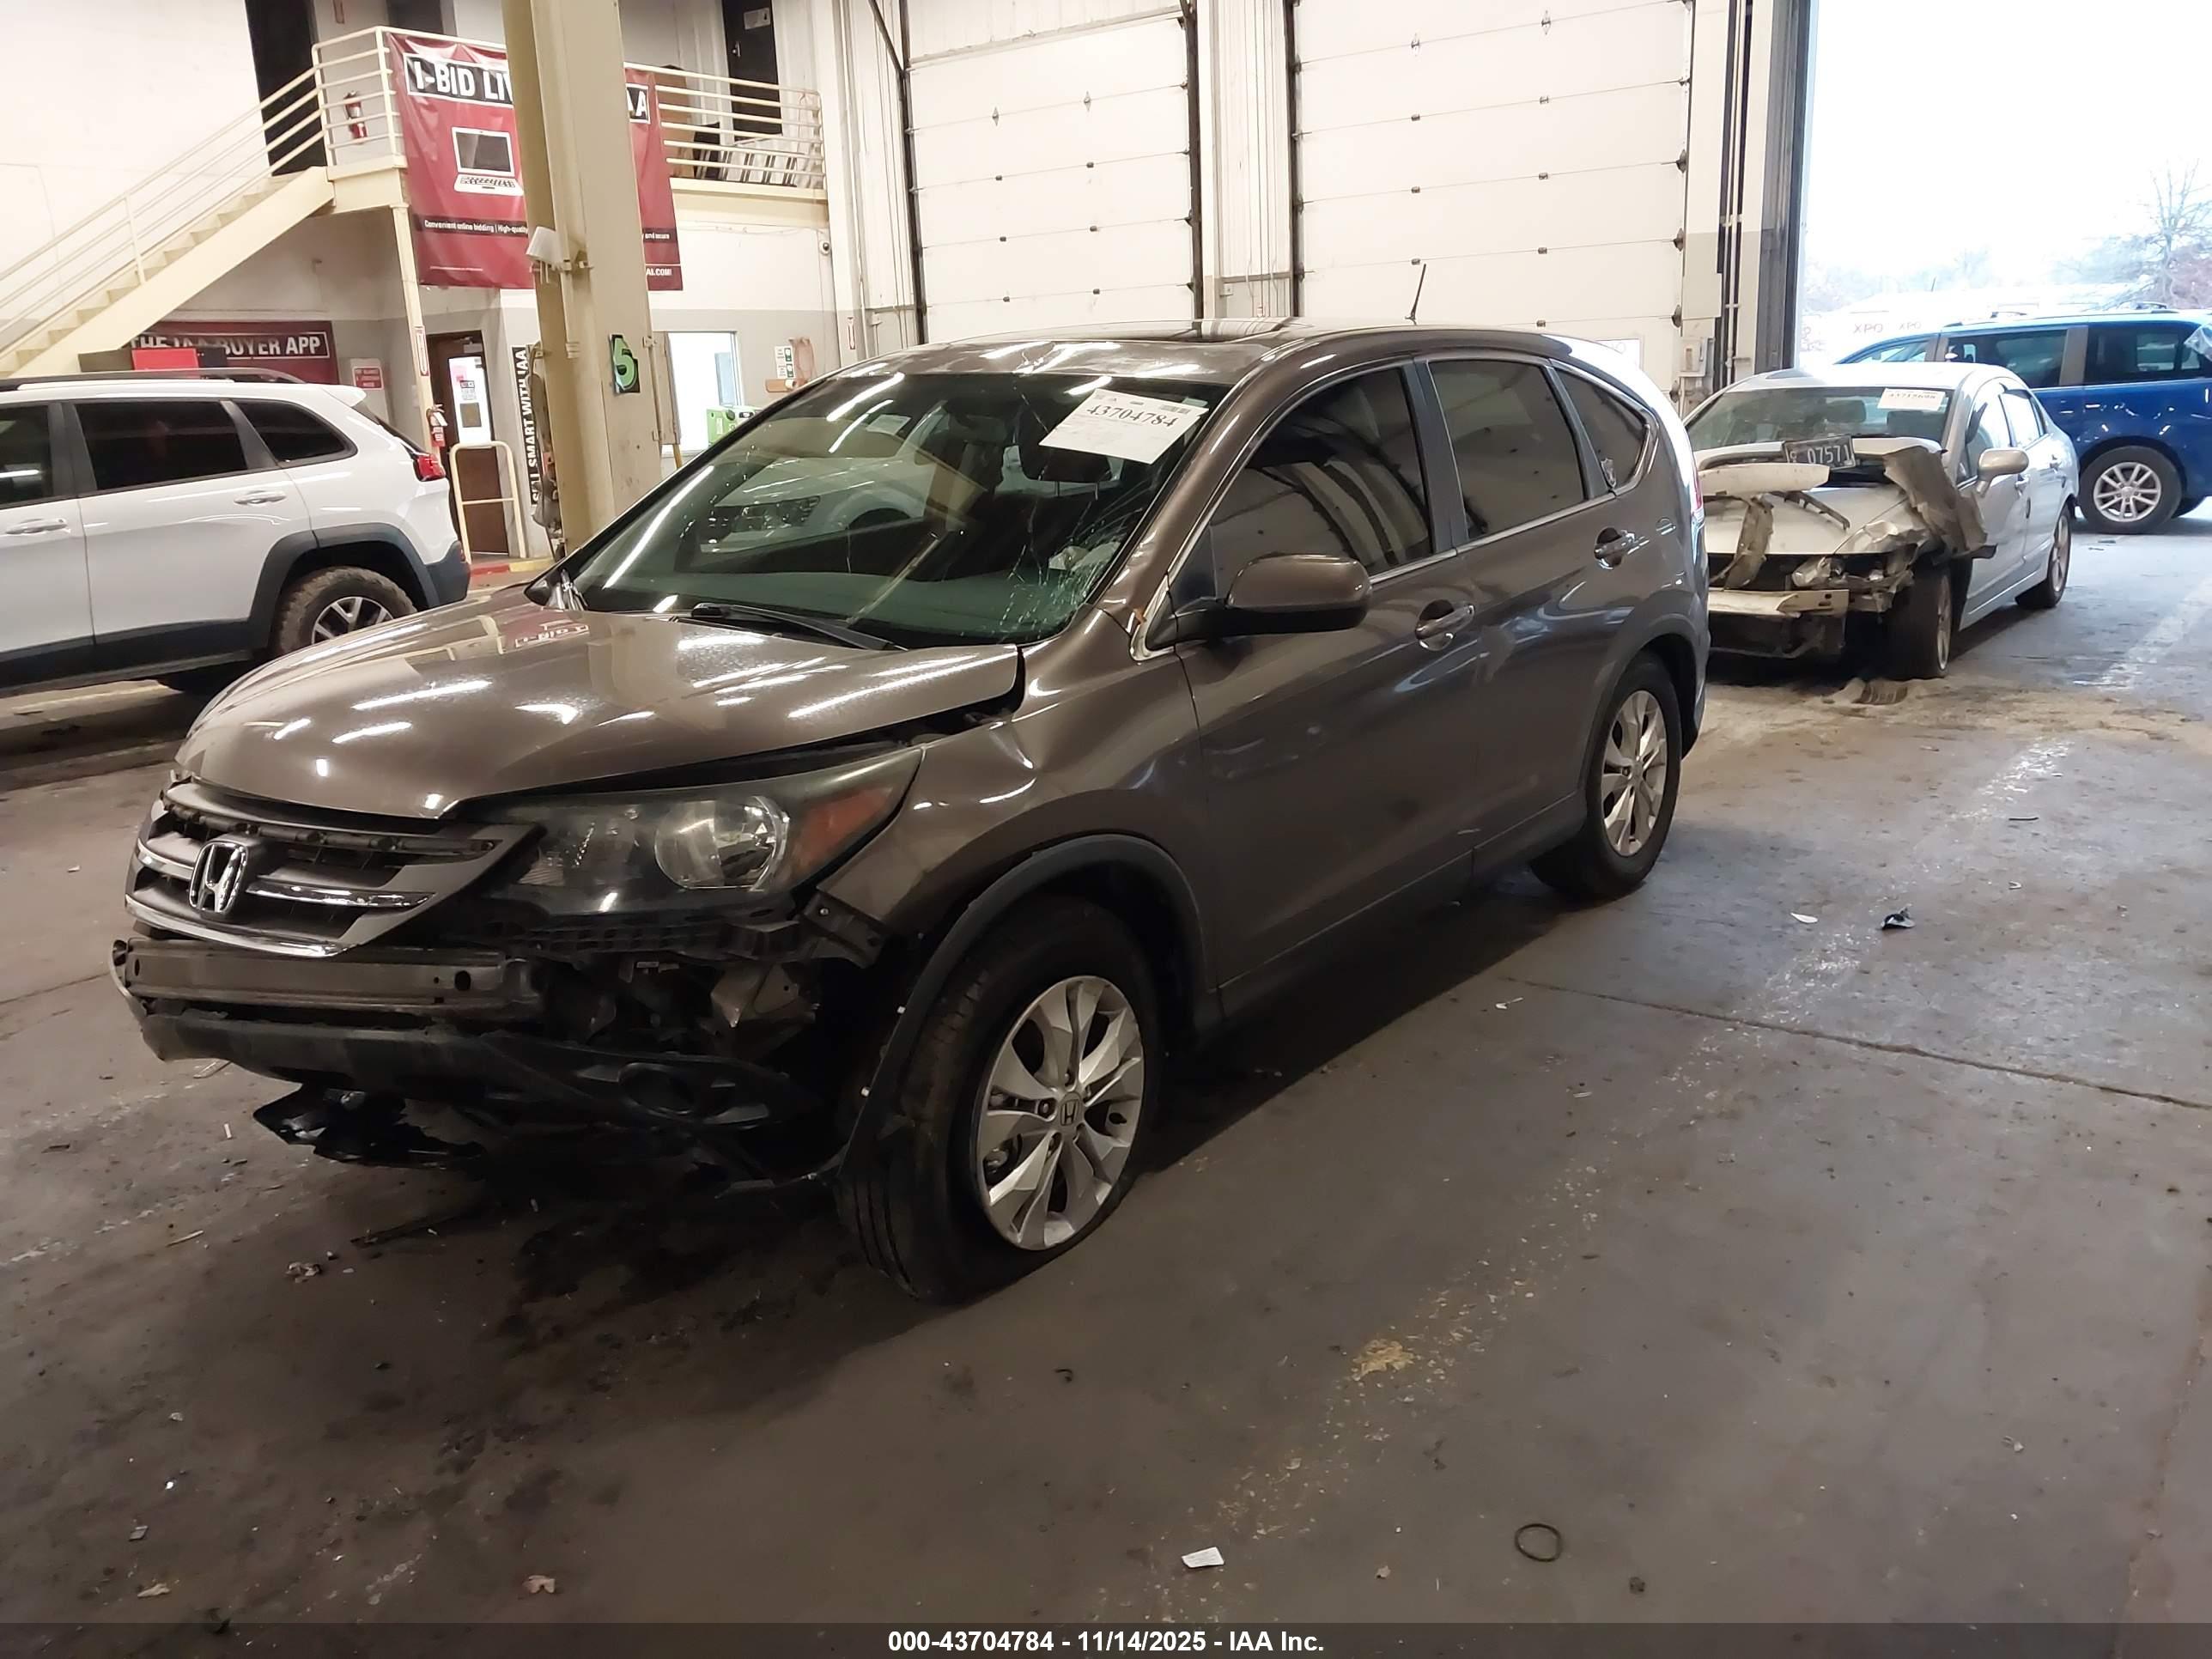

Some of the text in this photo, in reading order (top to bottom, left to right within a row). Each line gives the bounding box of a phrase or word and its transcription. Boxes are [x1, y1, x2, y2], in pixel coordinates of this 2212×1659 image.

[414, 61, 476, 97] I-BID
[424, 219, 456, 229] Convenient
[457, 222, 473, 231] online
[473, 224, 495, 233] bidding
[1853, 323, 1884, 334] XPO
[1899, 321, 1922, 331] XPO
[285, 336, 321, 354] APP
[515, 349, 529, 375] IAA
[613, 337, 637, 391] 5
[518, 379, 532, 416] WITH
[1087, 404, 1179, 427] 43704784
[523, 418, 538, 467] SMART
